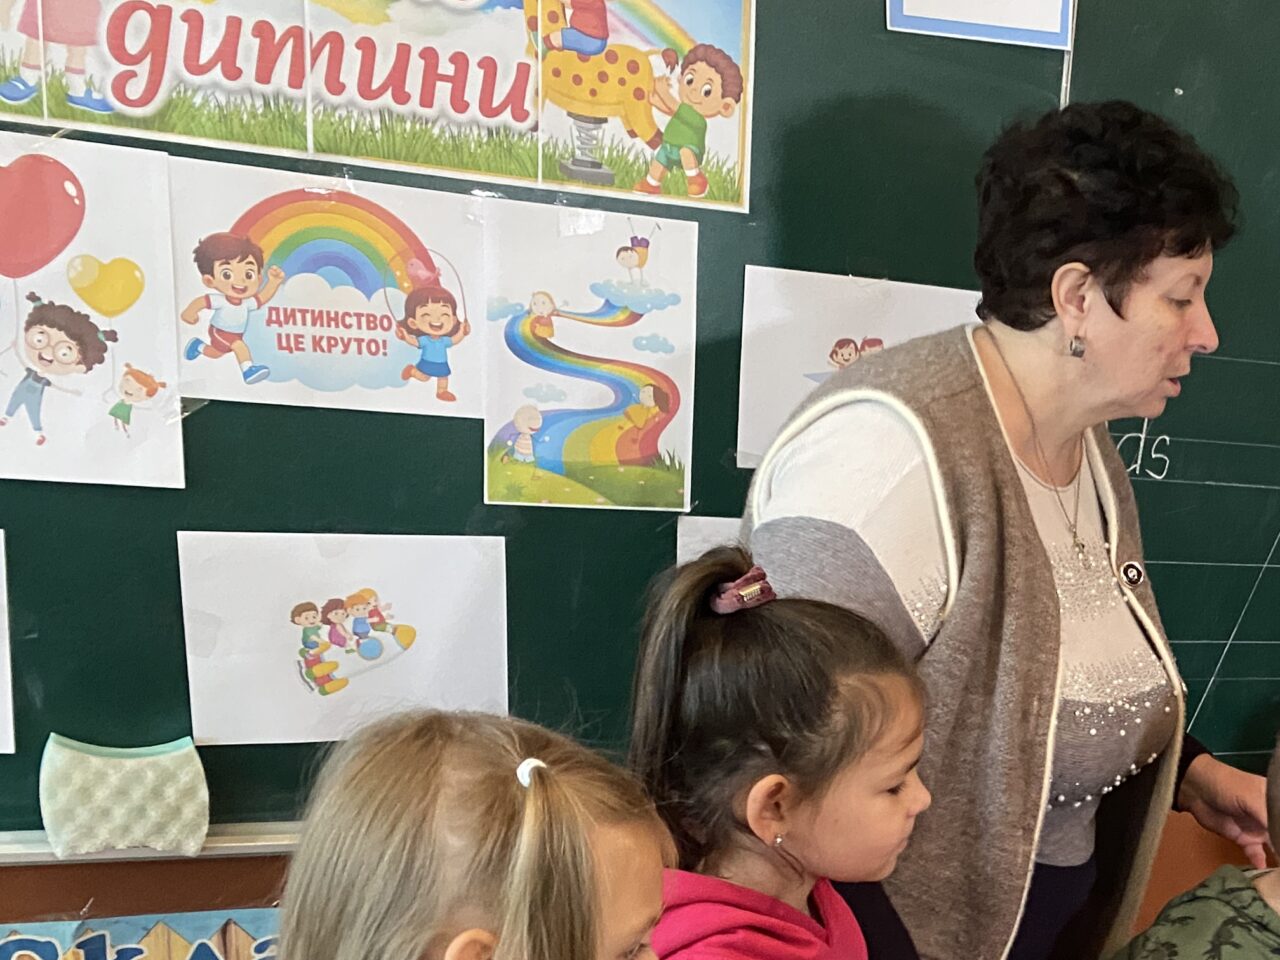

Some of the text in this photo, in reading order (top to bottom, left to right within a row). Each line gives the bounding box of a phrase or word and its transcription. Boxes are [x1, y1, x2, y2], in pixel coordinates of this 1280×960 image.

[105, 0, 534, 128] дитини
[265, 306, 393, 332] ДИТИНСТВО
[276, 332, 388, 356] ЦЕ КРУТО!
